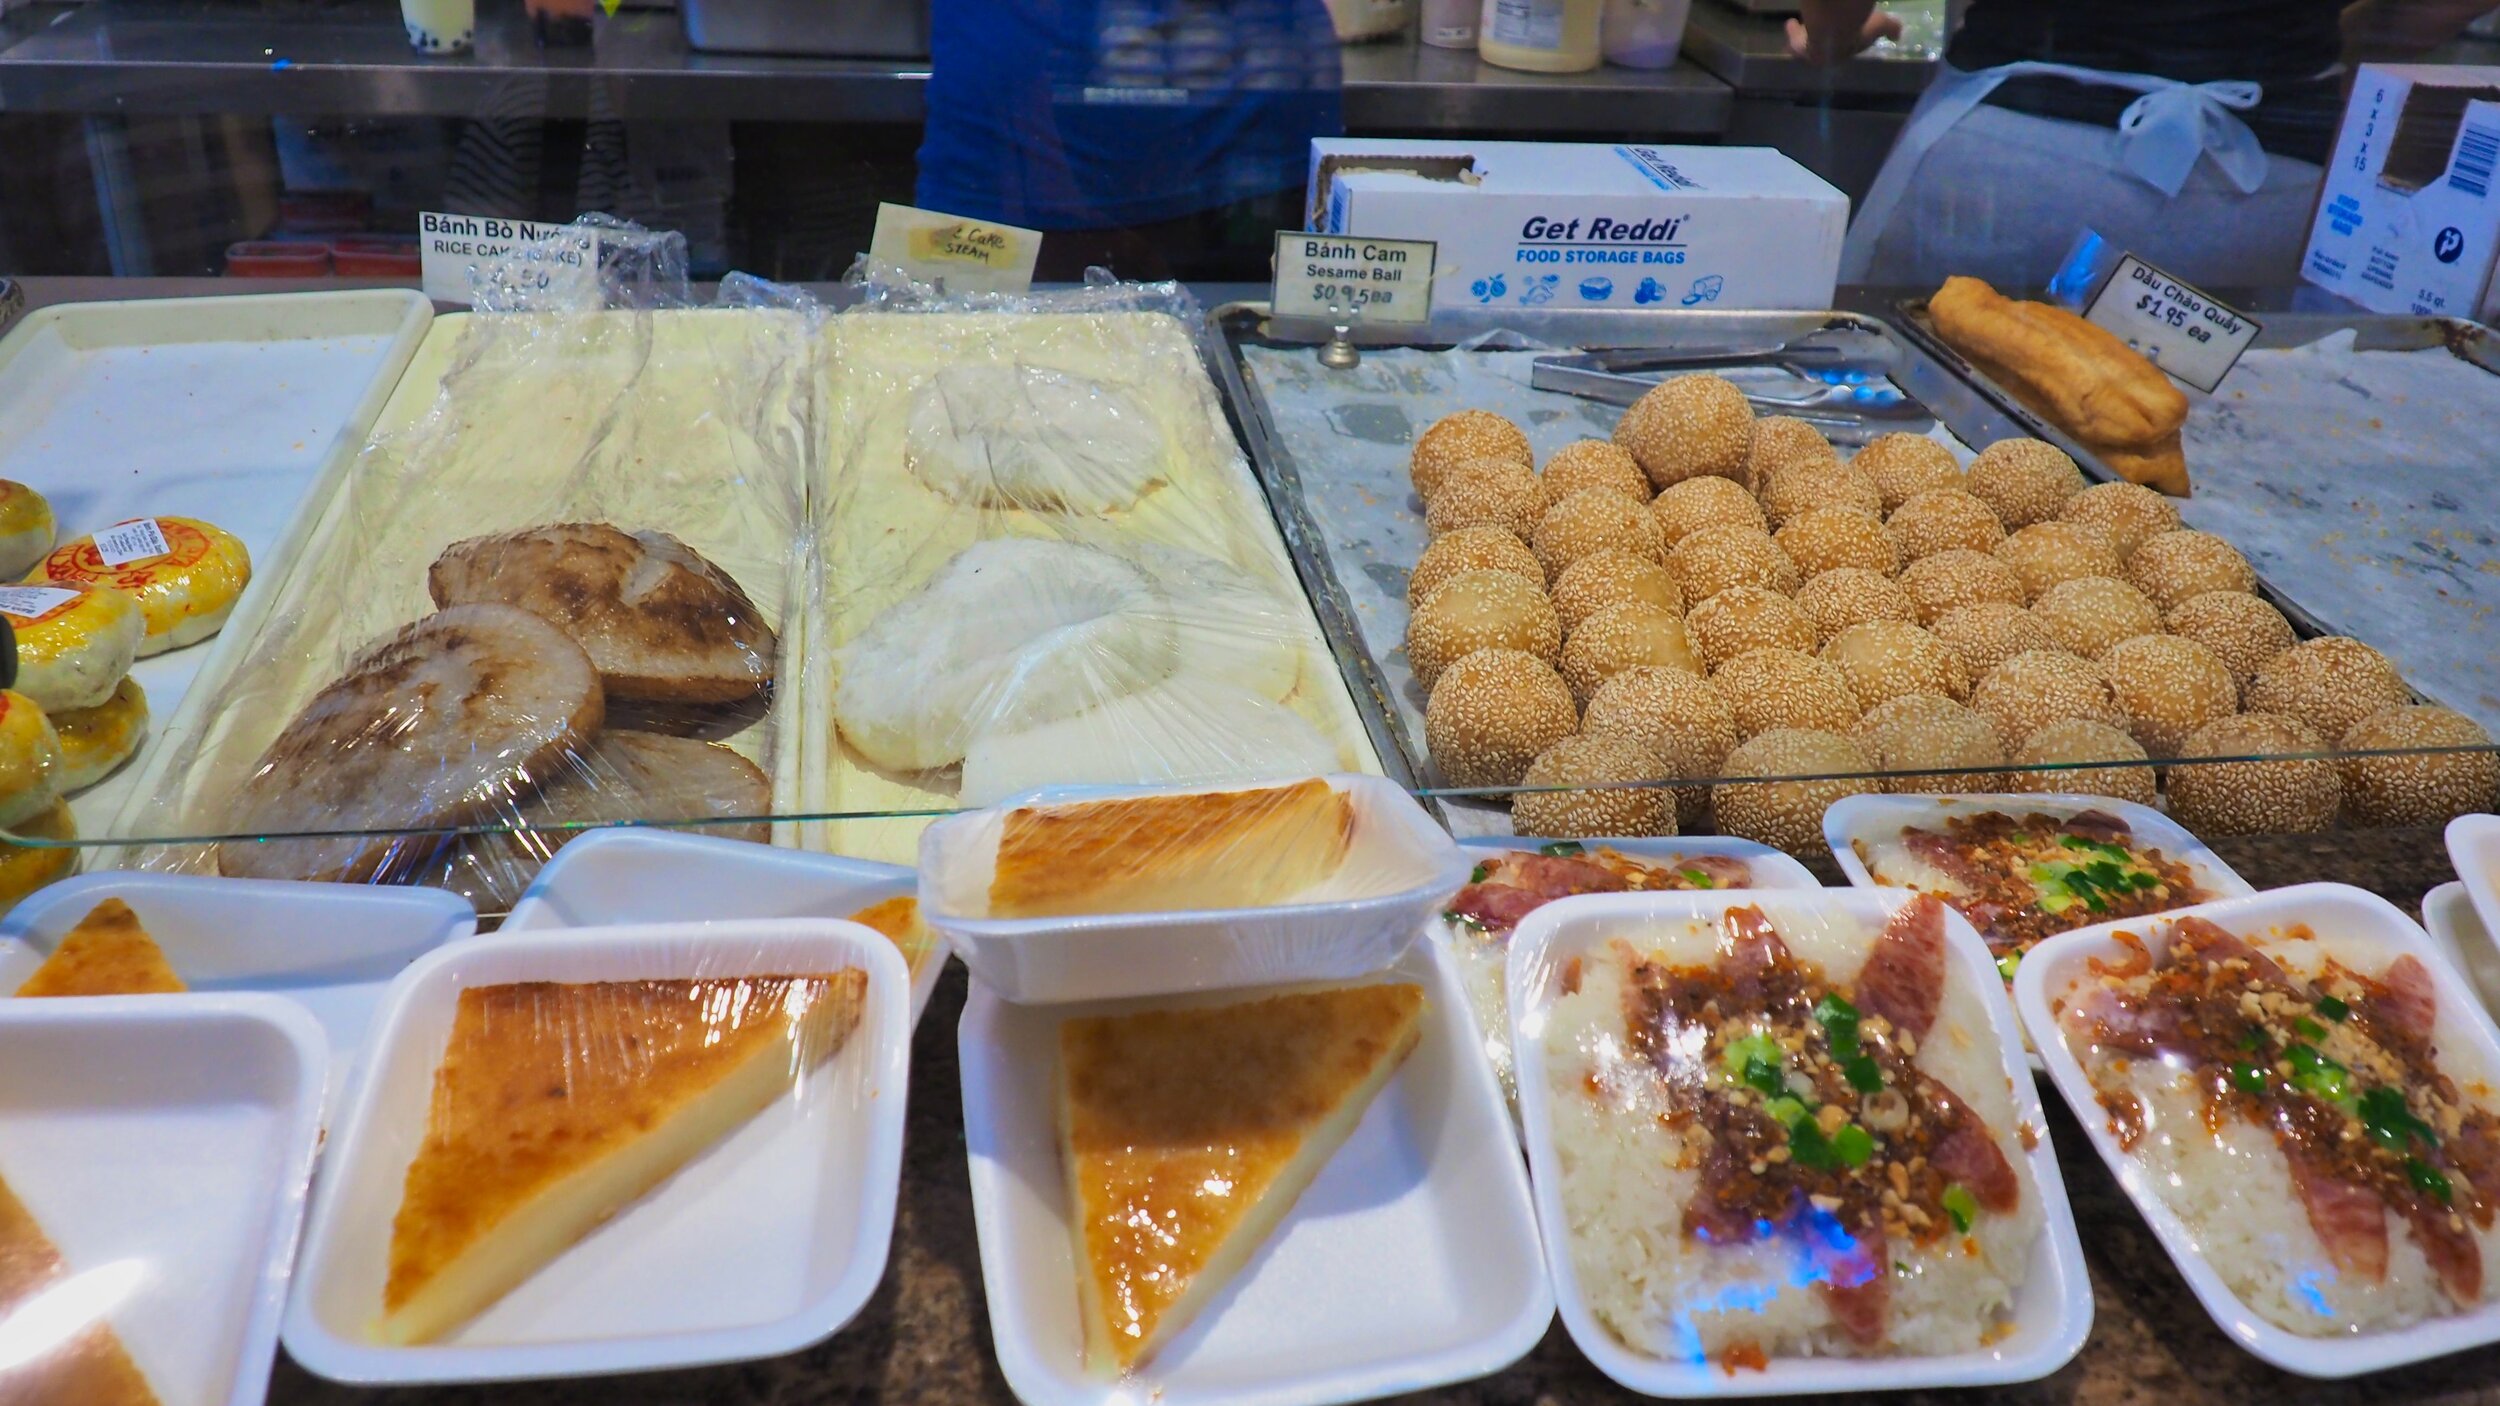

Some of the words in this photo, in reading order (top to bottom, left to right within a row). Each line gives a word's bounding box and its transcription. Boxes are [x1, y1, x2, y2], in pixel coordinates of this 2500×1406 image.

[2376, 89, 2385, 102] 6
[2365, 123, 2373, 137] 3
[2353, 156, 2367, 172] 15
[424, 214, 478, 236] Bánh
[485, 220, 513, 239] Bò
[1522, 216, 1580, 240] Get
[434, 240, 472, 255] RICE
[1305, 241, 1355, 260] Bánh
[1363, 244, 1407, 262] Cam
[1516, 249, 1561, 263] FOOD
[1565, 250, 1638, 264] STORAGE
[1643, 251, 1686, 264] BAGS
[1307, 263, 1367, 280] Sesame
[1373, 268, 1402, 281] Ball
[2136, 295, 2189, 328] $1.95
[2187, 322, 2213, 344] ea
